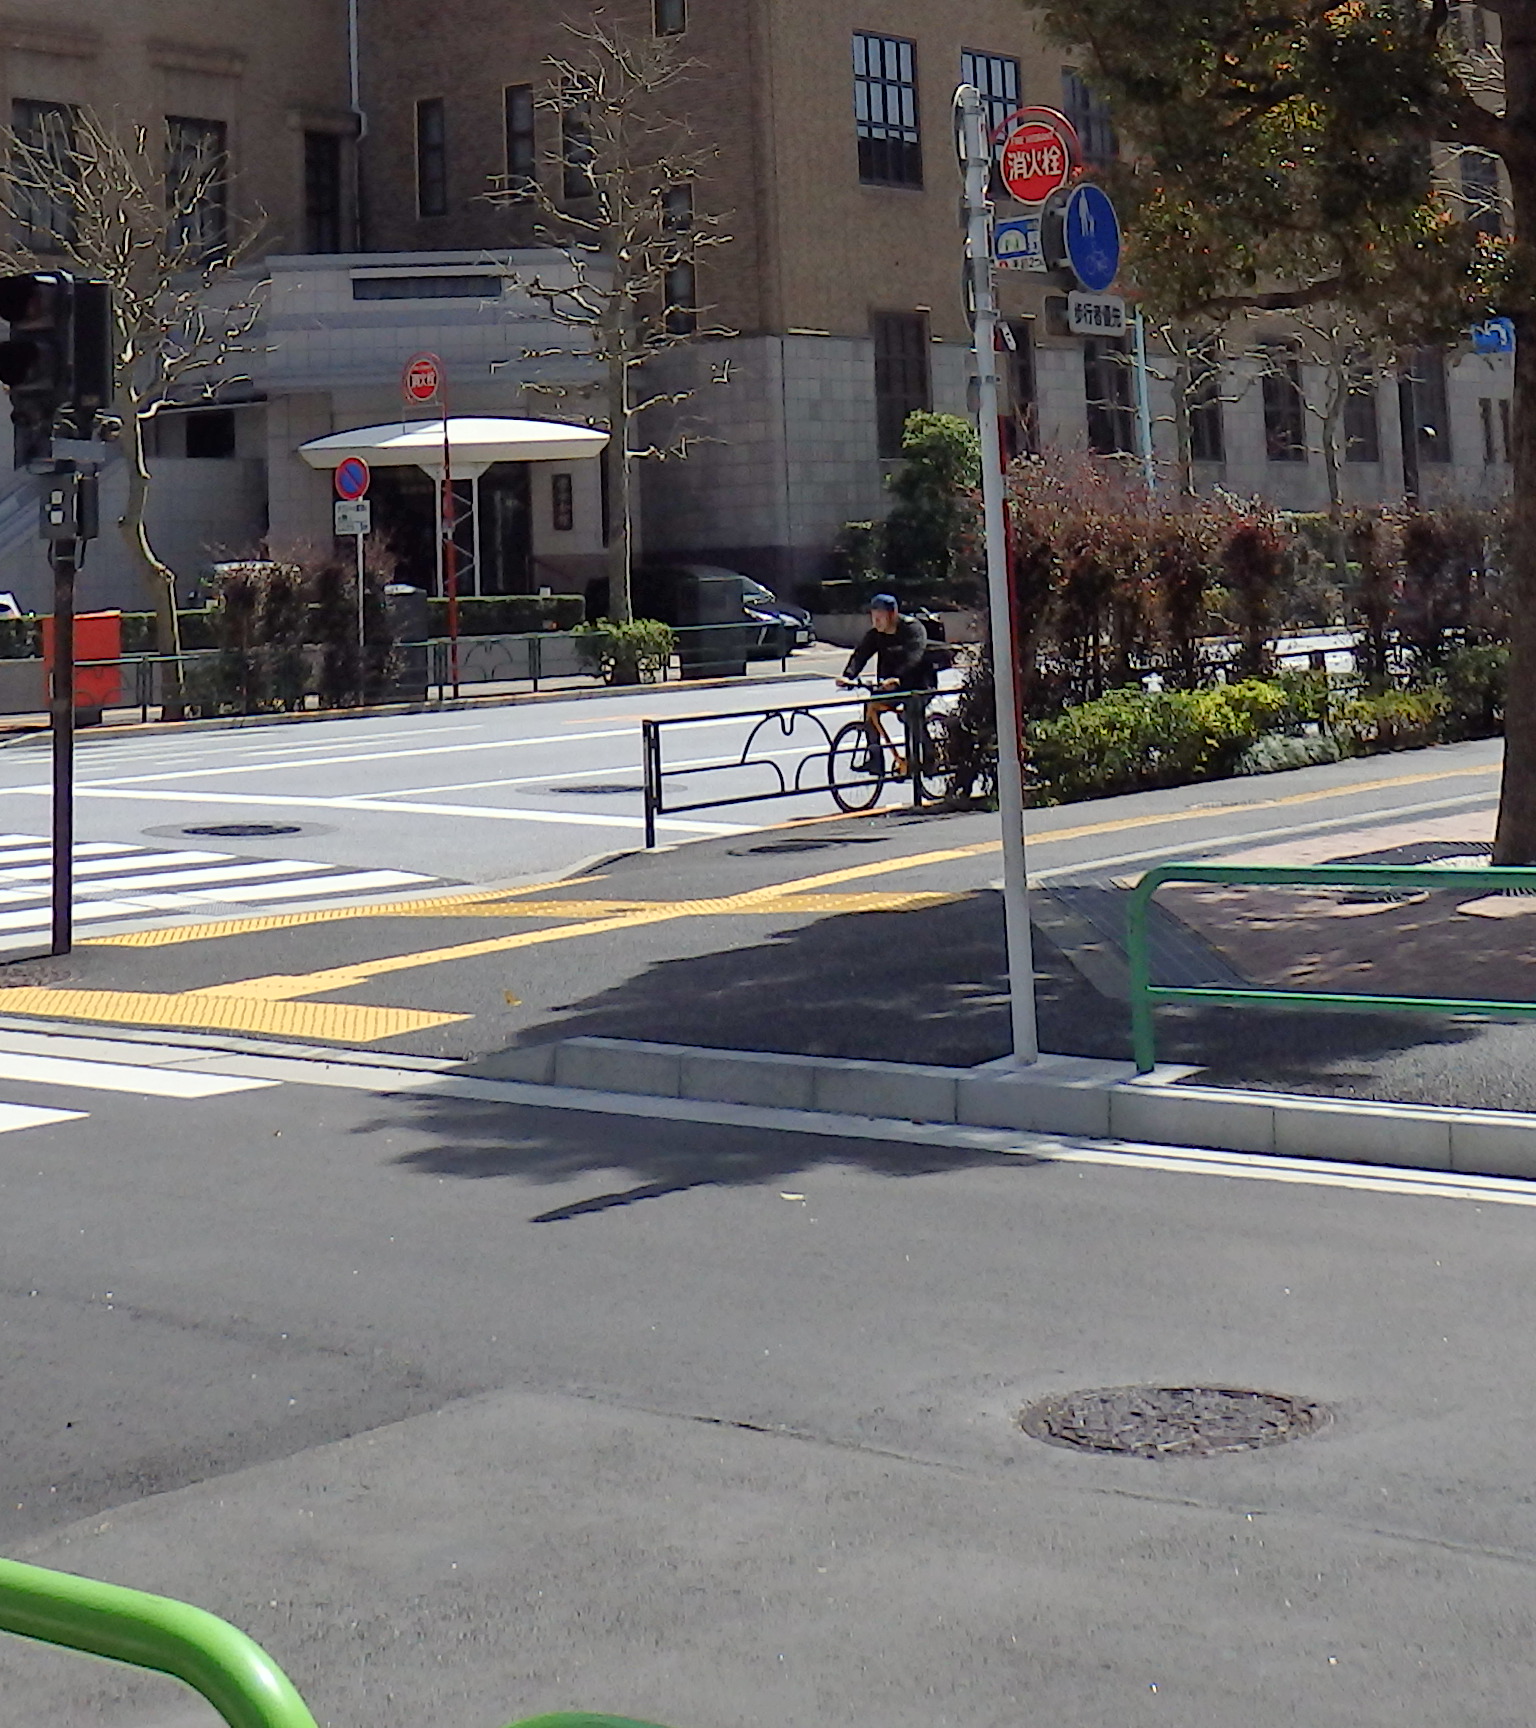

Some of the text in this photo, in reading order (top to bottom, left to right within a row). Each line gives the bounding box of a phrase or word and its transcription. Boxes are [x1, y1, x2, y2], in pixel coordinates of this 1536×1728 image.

[1007, 145, 1062, 182] 消火栓
[1075, 303, 1121, 328] 歩行者優先
